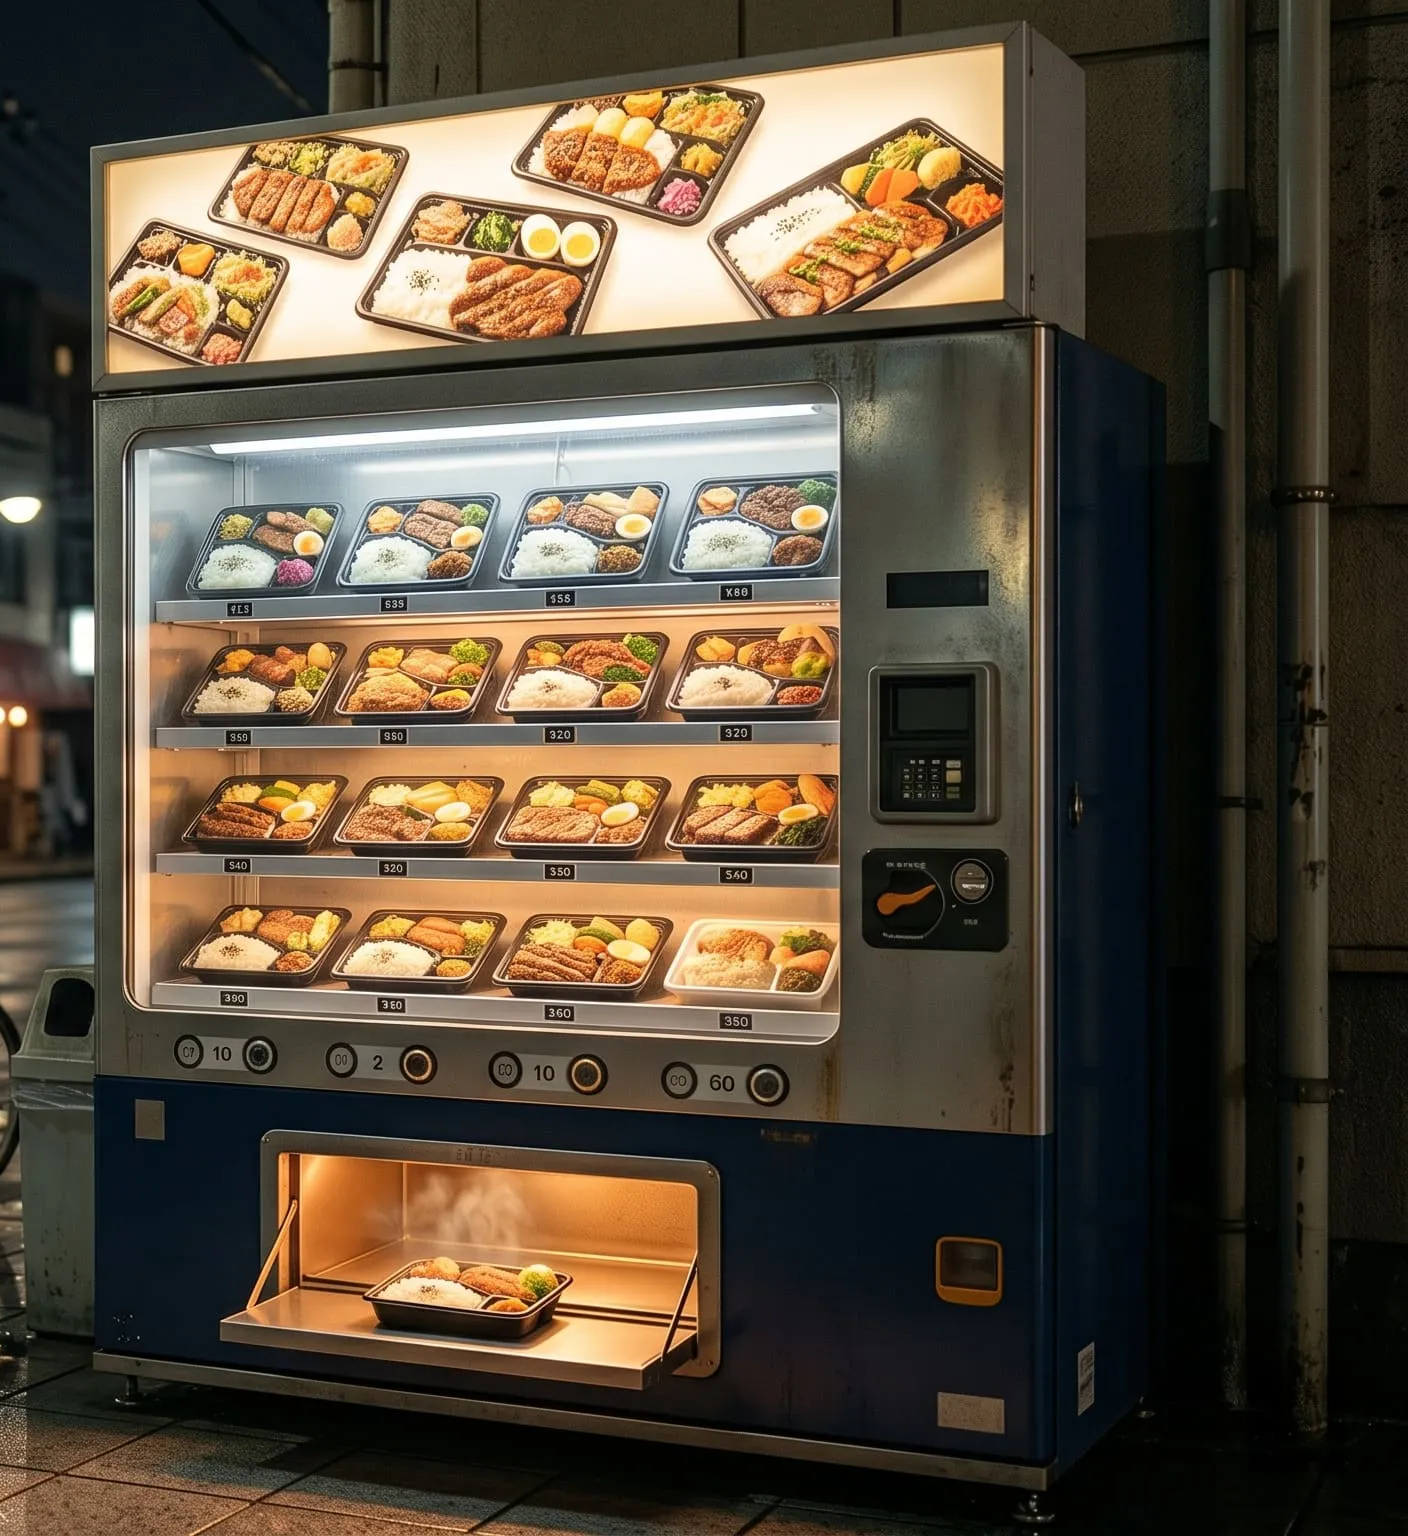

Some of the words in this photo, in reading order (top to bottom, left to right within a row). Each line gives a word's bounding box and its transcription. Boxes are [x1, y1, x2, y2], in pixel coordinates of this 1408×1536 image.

[549, 730, 571, 740] 320
[725, 727, 748, 738] 320
[548, 1007, 572, 1019] 360
[212, 1046, 232, 1061] 10
[372, 1054, 384, 1071] 2
[533, 1064, 555, 1081] 10
[709, 1074, 735, 1092] 60
